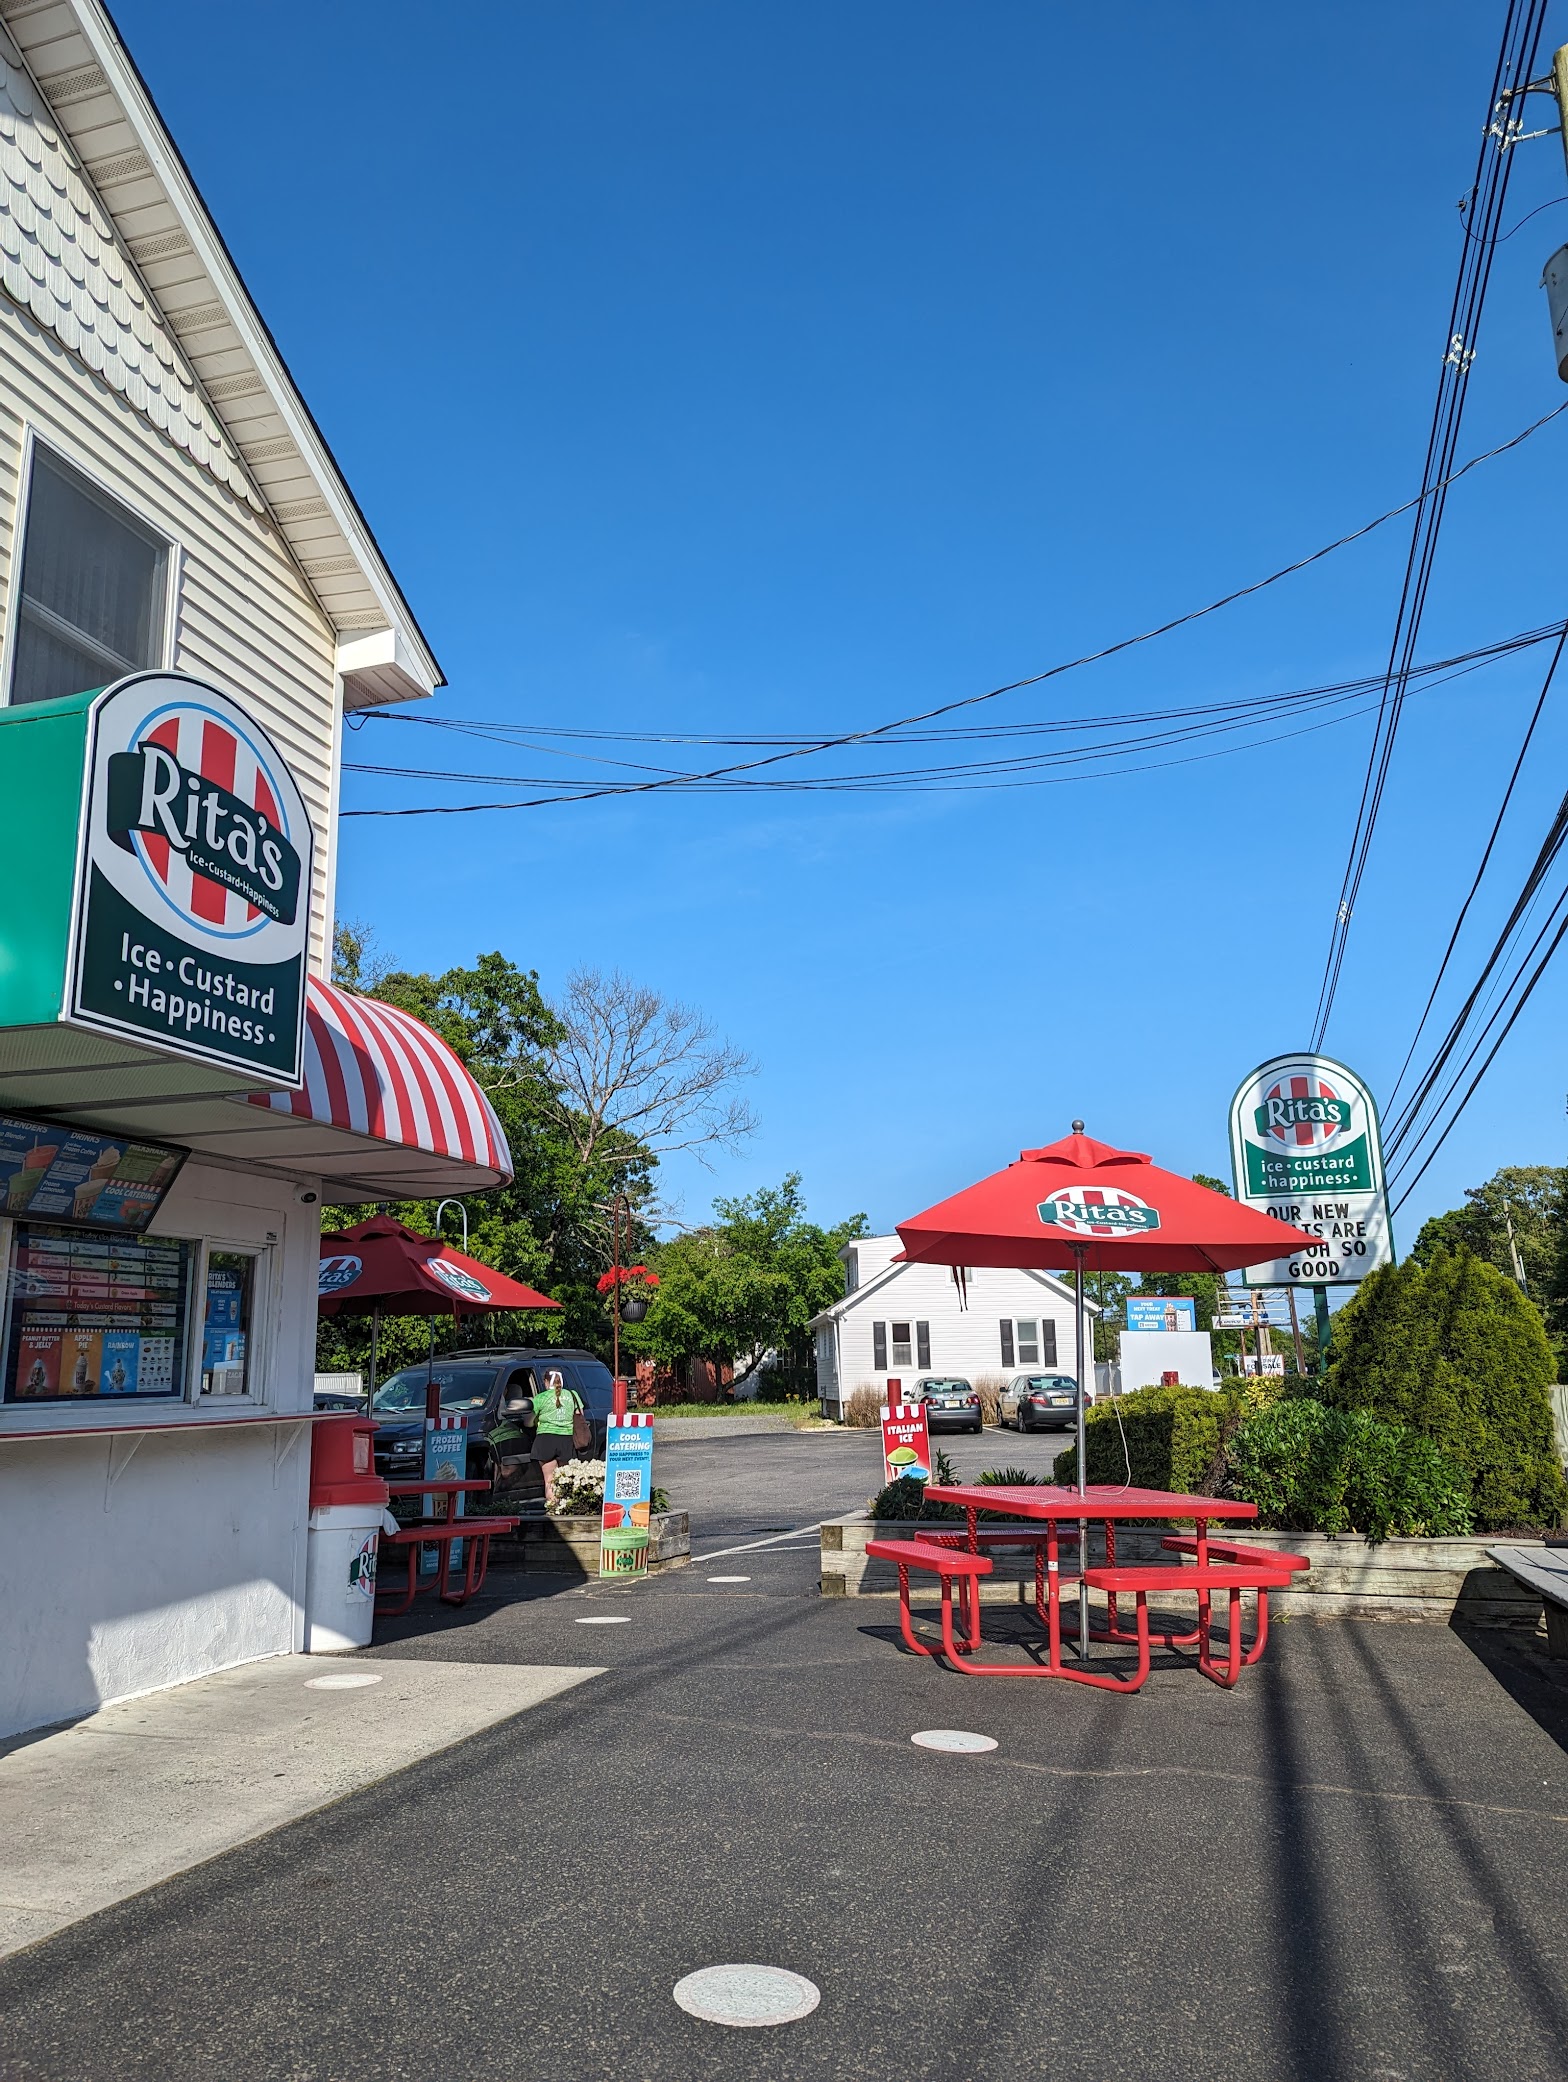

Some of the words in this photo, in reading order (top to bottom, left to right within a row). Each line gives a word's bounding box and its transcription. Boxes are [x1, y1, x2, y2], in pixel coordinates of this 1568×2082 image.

[138, 746, 284, 891] Rita's
[189, 850, 206, 867] Ice
[208, 857, 241, 887] Custard
[243, 881, 280, 918] Happiness
[121, 932, 161, 970] Ice
[178, 957, 275, 1016] Custard
[129, 973, 266, 1045] Happiness
[1266, 1097, 1342, 1127] Rita's
[2, 1119, 49, 1134] BLENDERS
[70, 1132, 102, 1144] DRINKS
[62, 1145, 80, 1153] Frozen
[80, 1148, 97, 1156] Coffee
[1261, 1160, 1283, 1173] ice
[1294, 1155, 1354, 1171] custard
[1268, 1173, 1350, 1190] happiness
[105, 1187, 124, 1196] COOL
[123, 1190, 158, 1201] CATERING
[1053, 1200, 1147, 1223] Rita's
[1266, 1206, 1301, 1221] OUR
[1312, 1203, 1349, 1219] NEW
[1332, 1222, 1367, 1237] ARE
[1341, 1241, 1367, 1257] SO
[1288, 1261, 1340, 1278] GOOD
[74, 1302, 93, 1310] Today's
[94, 1302, 113, 1310] Custard
[887, 1423, 923, 1435] ITALIAN
[431, 1435, 463, 1445] FROZEN
[620, 1433, 641, 1441] COOL
[899, 1433, 914, 1443] ICE
[432, 1444, 462, 1453] COFFEE
[609, 1442, 650, 1451] CATERING
